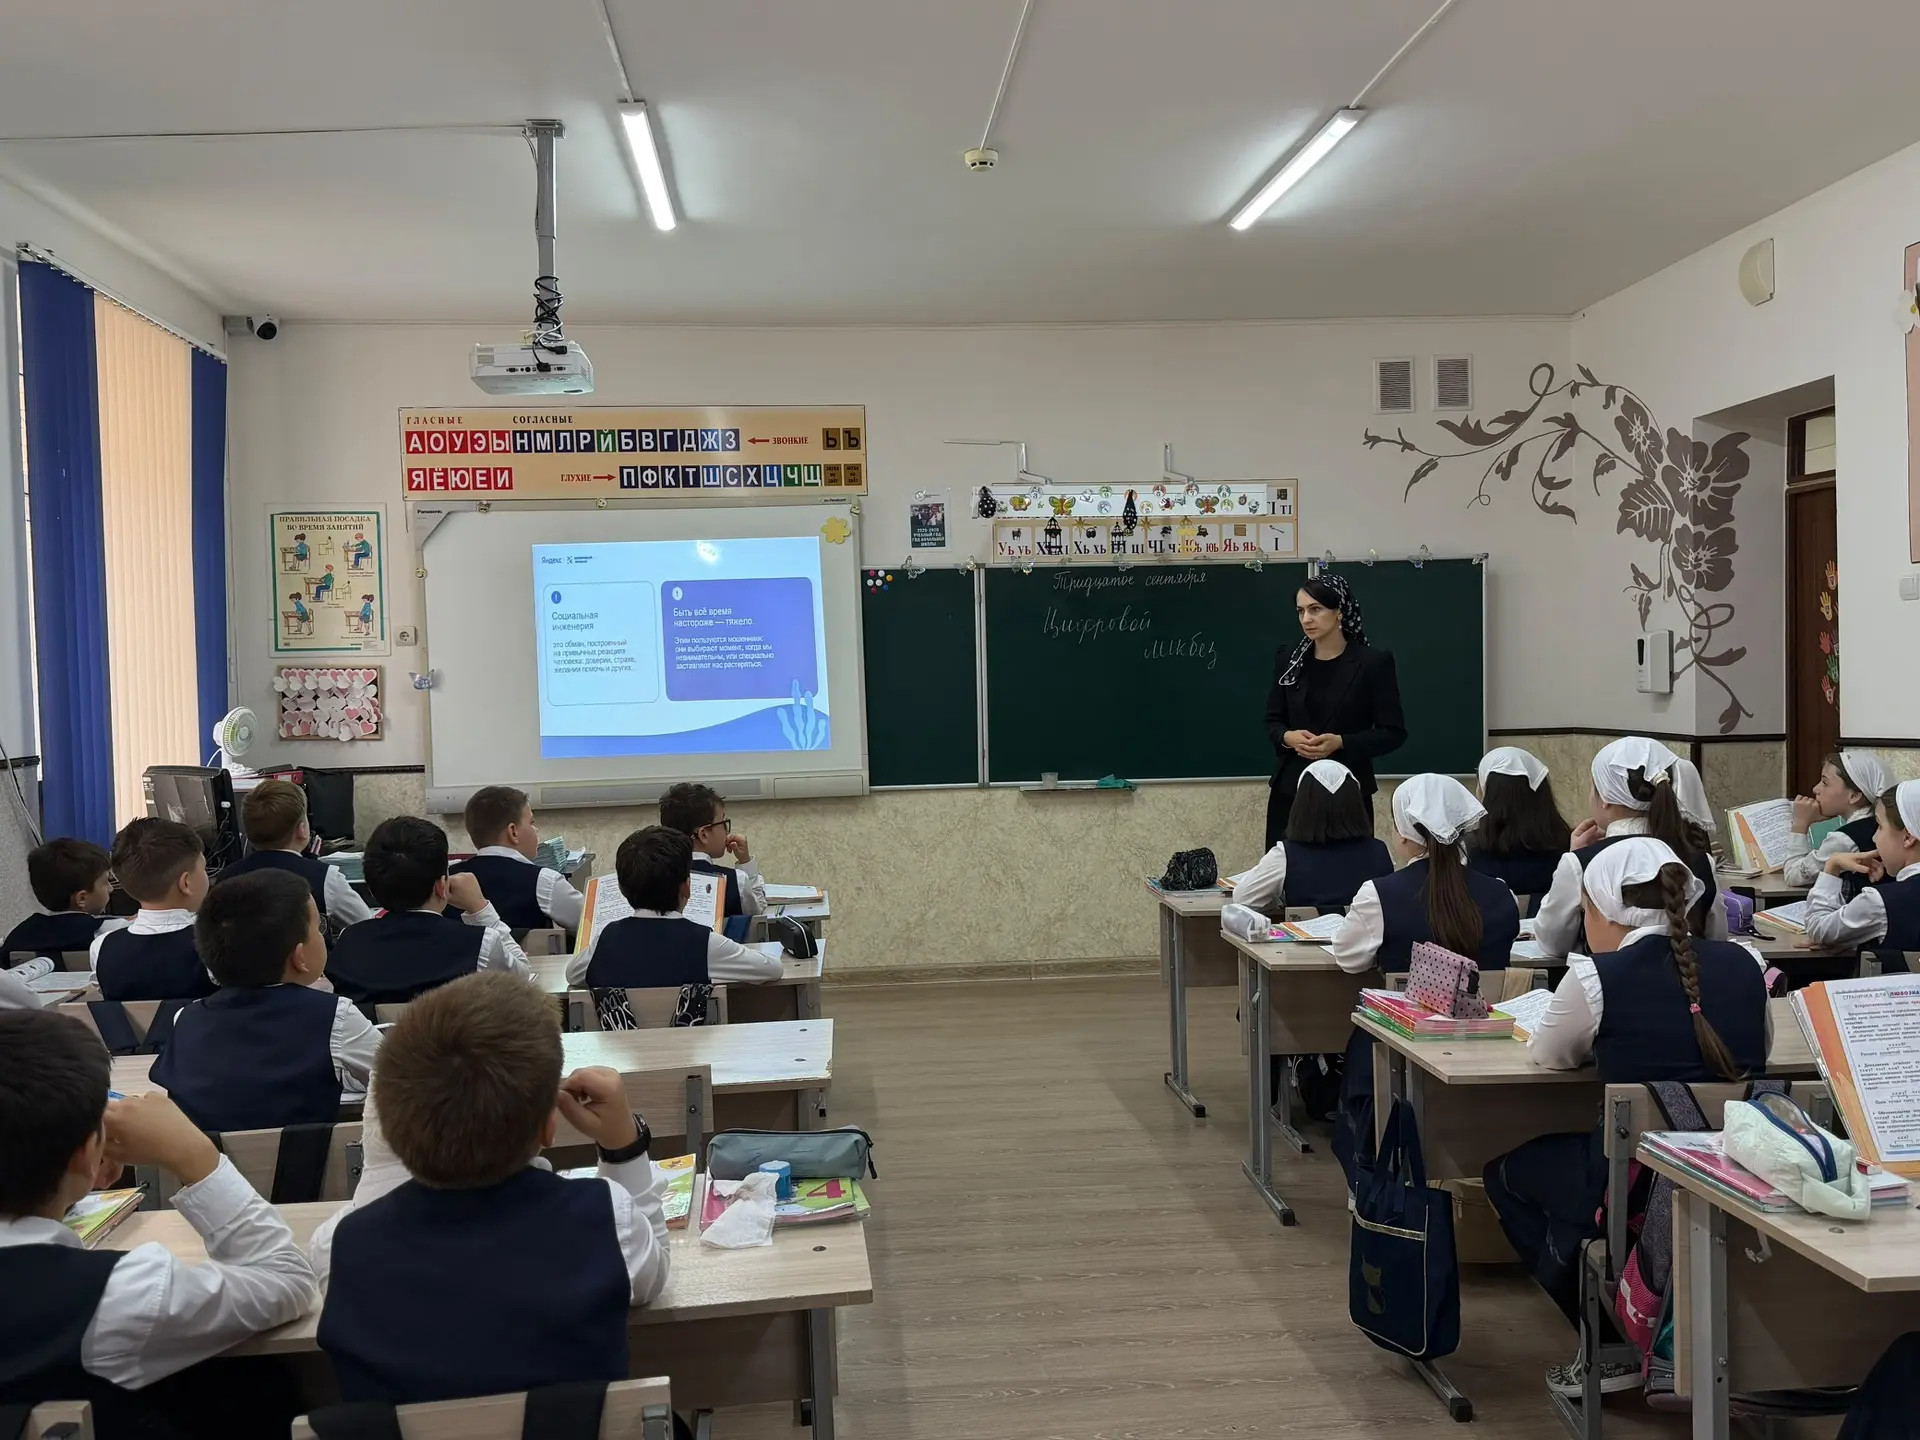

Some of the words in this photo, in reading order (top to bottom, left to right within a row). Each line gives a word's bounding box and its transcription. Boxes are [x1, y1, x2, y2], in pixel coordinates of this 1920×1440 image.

[407, 416, 463, 425] ГЛАСНЫЕ
[513, 415, 573, 424] СОГЛАСНЫЕ
[772, 436, 809, 445] ЗВОНКИЕ
[561, 473, 592, 483] ГЛУХИЕ
[326, 523, 364, 531] ЗАНЯТИЙ
[542, 556, 562, 564] Яндекс
[1053, 571, 1135, 597] Тридцатое
[1145, 568, 1208, 590] сентября
[552, 611, 599, 621] Социальная
[673, 608, 692, 616] Быть
[694, 607, 707, 616] всё
[709, 608, 732, 617] время
[552, 623, 594, 632] инженерия
[674, 619, 713, 628] настороже
[1043, 605, 1151, 645] Цифровой
[587, 639, 627, 647] построенный
[692, 636, 727, 644] пользуются
[688, 645, 717, 653] выбирают
[1144, 632, 1217, 670] ликбез
